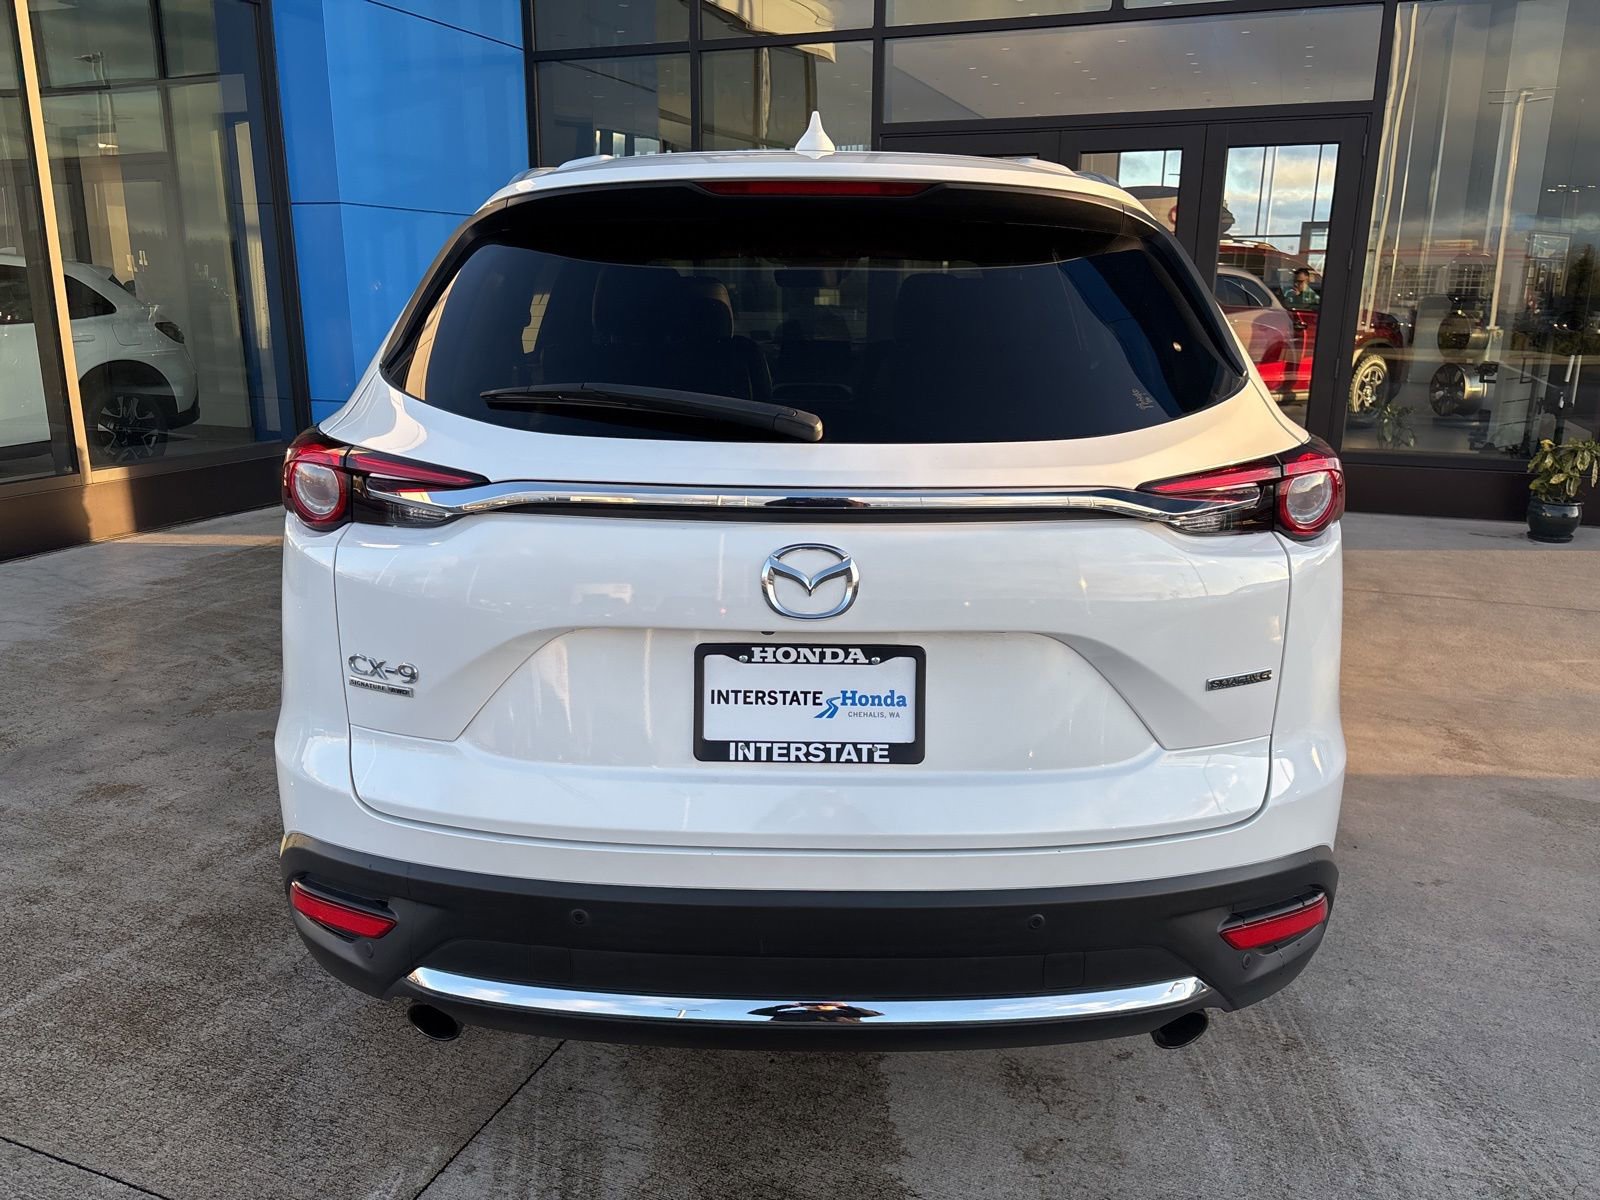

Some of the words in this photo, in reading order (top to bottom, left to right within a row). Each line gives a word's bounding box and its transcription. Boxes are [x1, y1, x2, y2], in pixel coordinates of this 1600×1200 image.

[751, 647, 869, 664] HONDA
[348, 653, 419, 684] CX-9
[350, 679, 386, 691] SIGNATURE
[710, 689, 823, 706] INTERSTATE
[840, 690, 907, 707] Honda
[847, 711, 887, 719] CHEHALIS,
[729, 742, 890, 763] INTERSTATE
